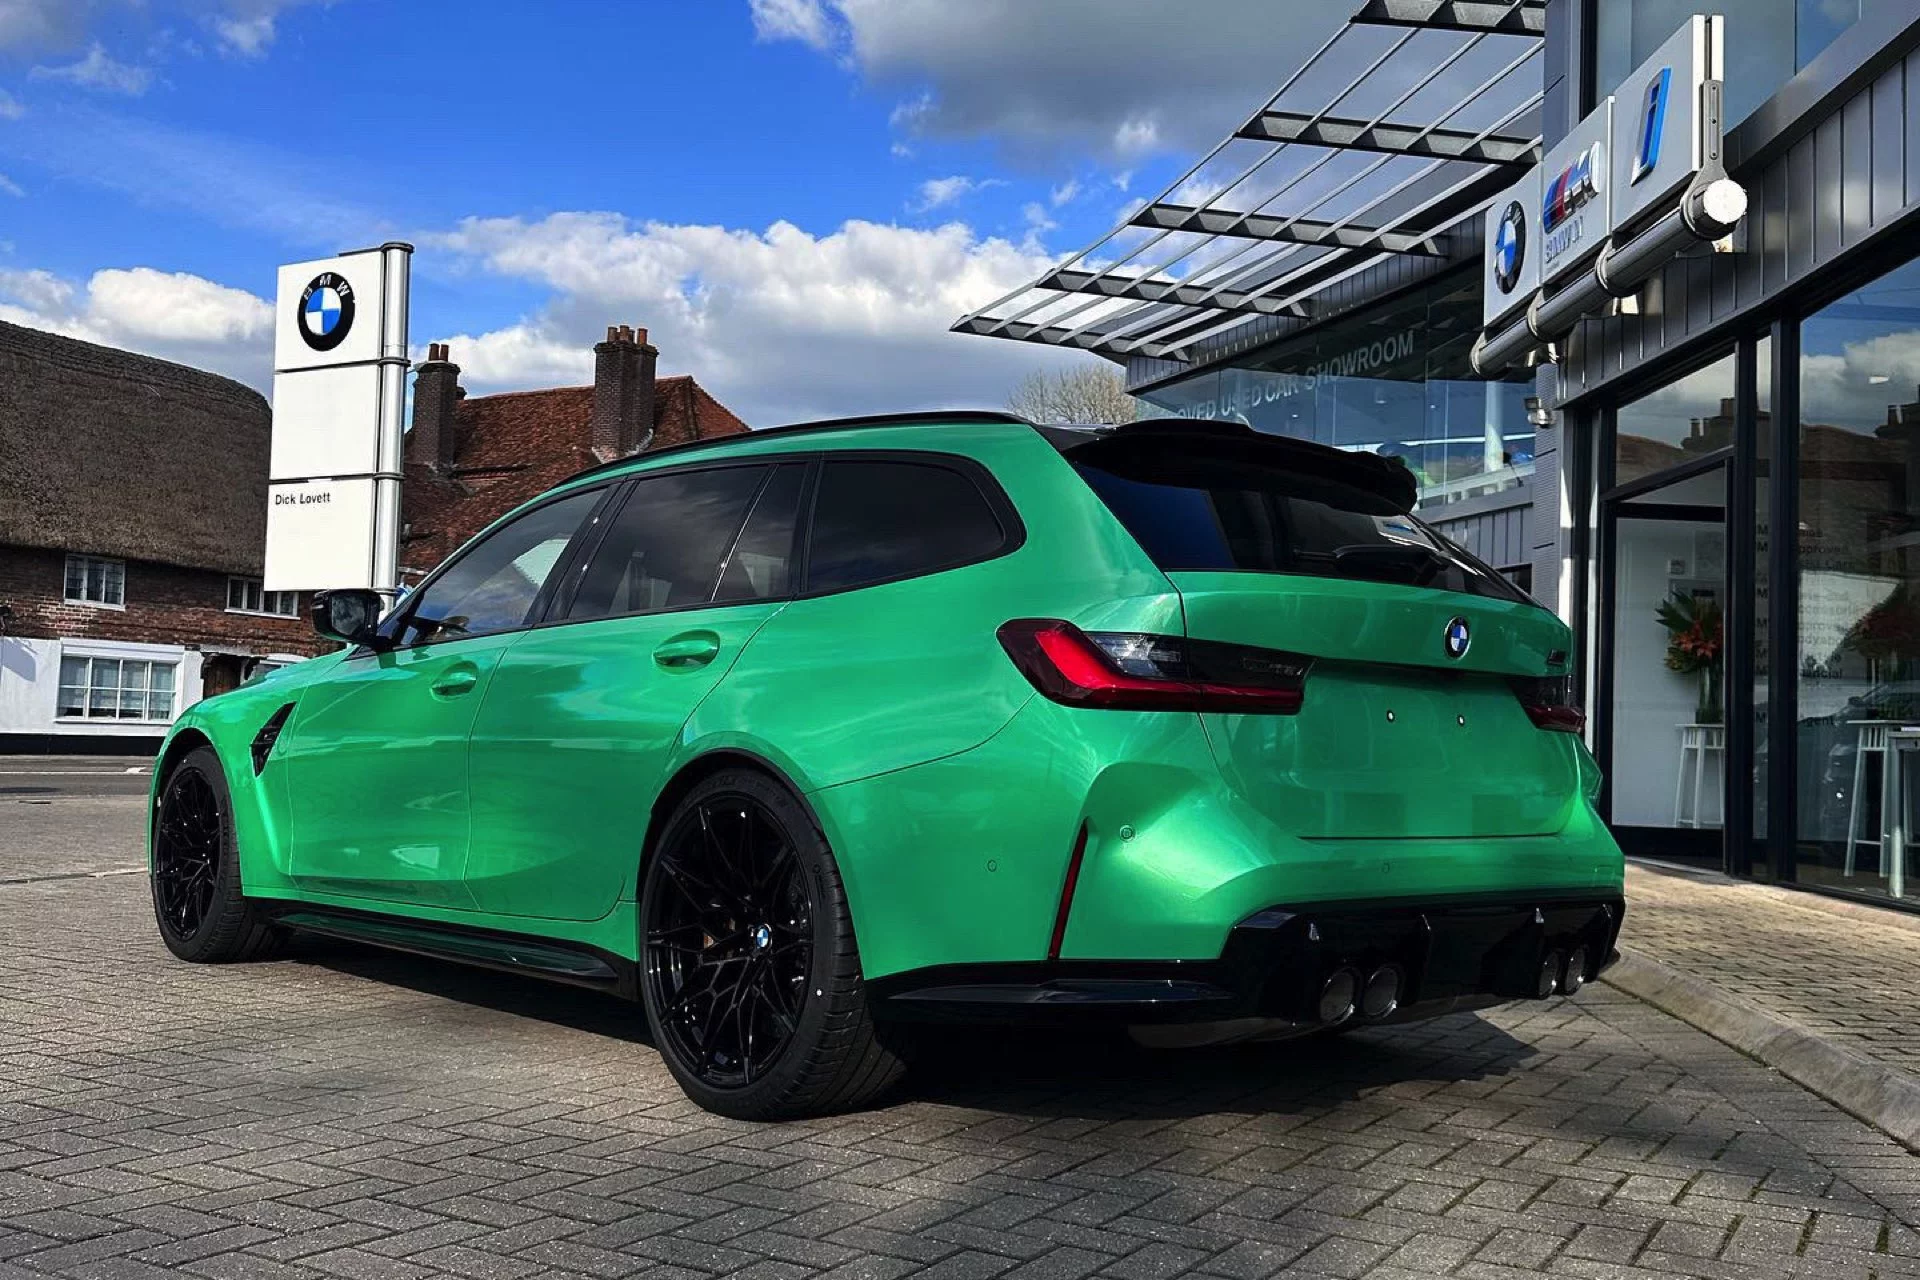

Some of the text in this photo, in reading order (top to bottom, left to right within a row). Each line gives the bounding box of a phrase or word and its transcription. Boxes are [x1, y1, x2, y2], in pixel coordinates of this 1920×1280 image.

[303, 273, 351, 301] BMW
[1221, 385, 1261, 416] USED
[1265, 376, 1298, 402] CAR
[1304, 330, 1414, 389] SHOWROOM
[275, 492, 331, 505] Dick Lovett
